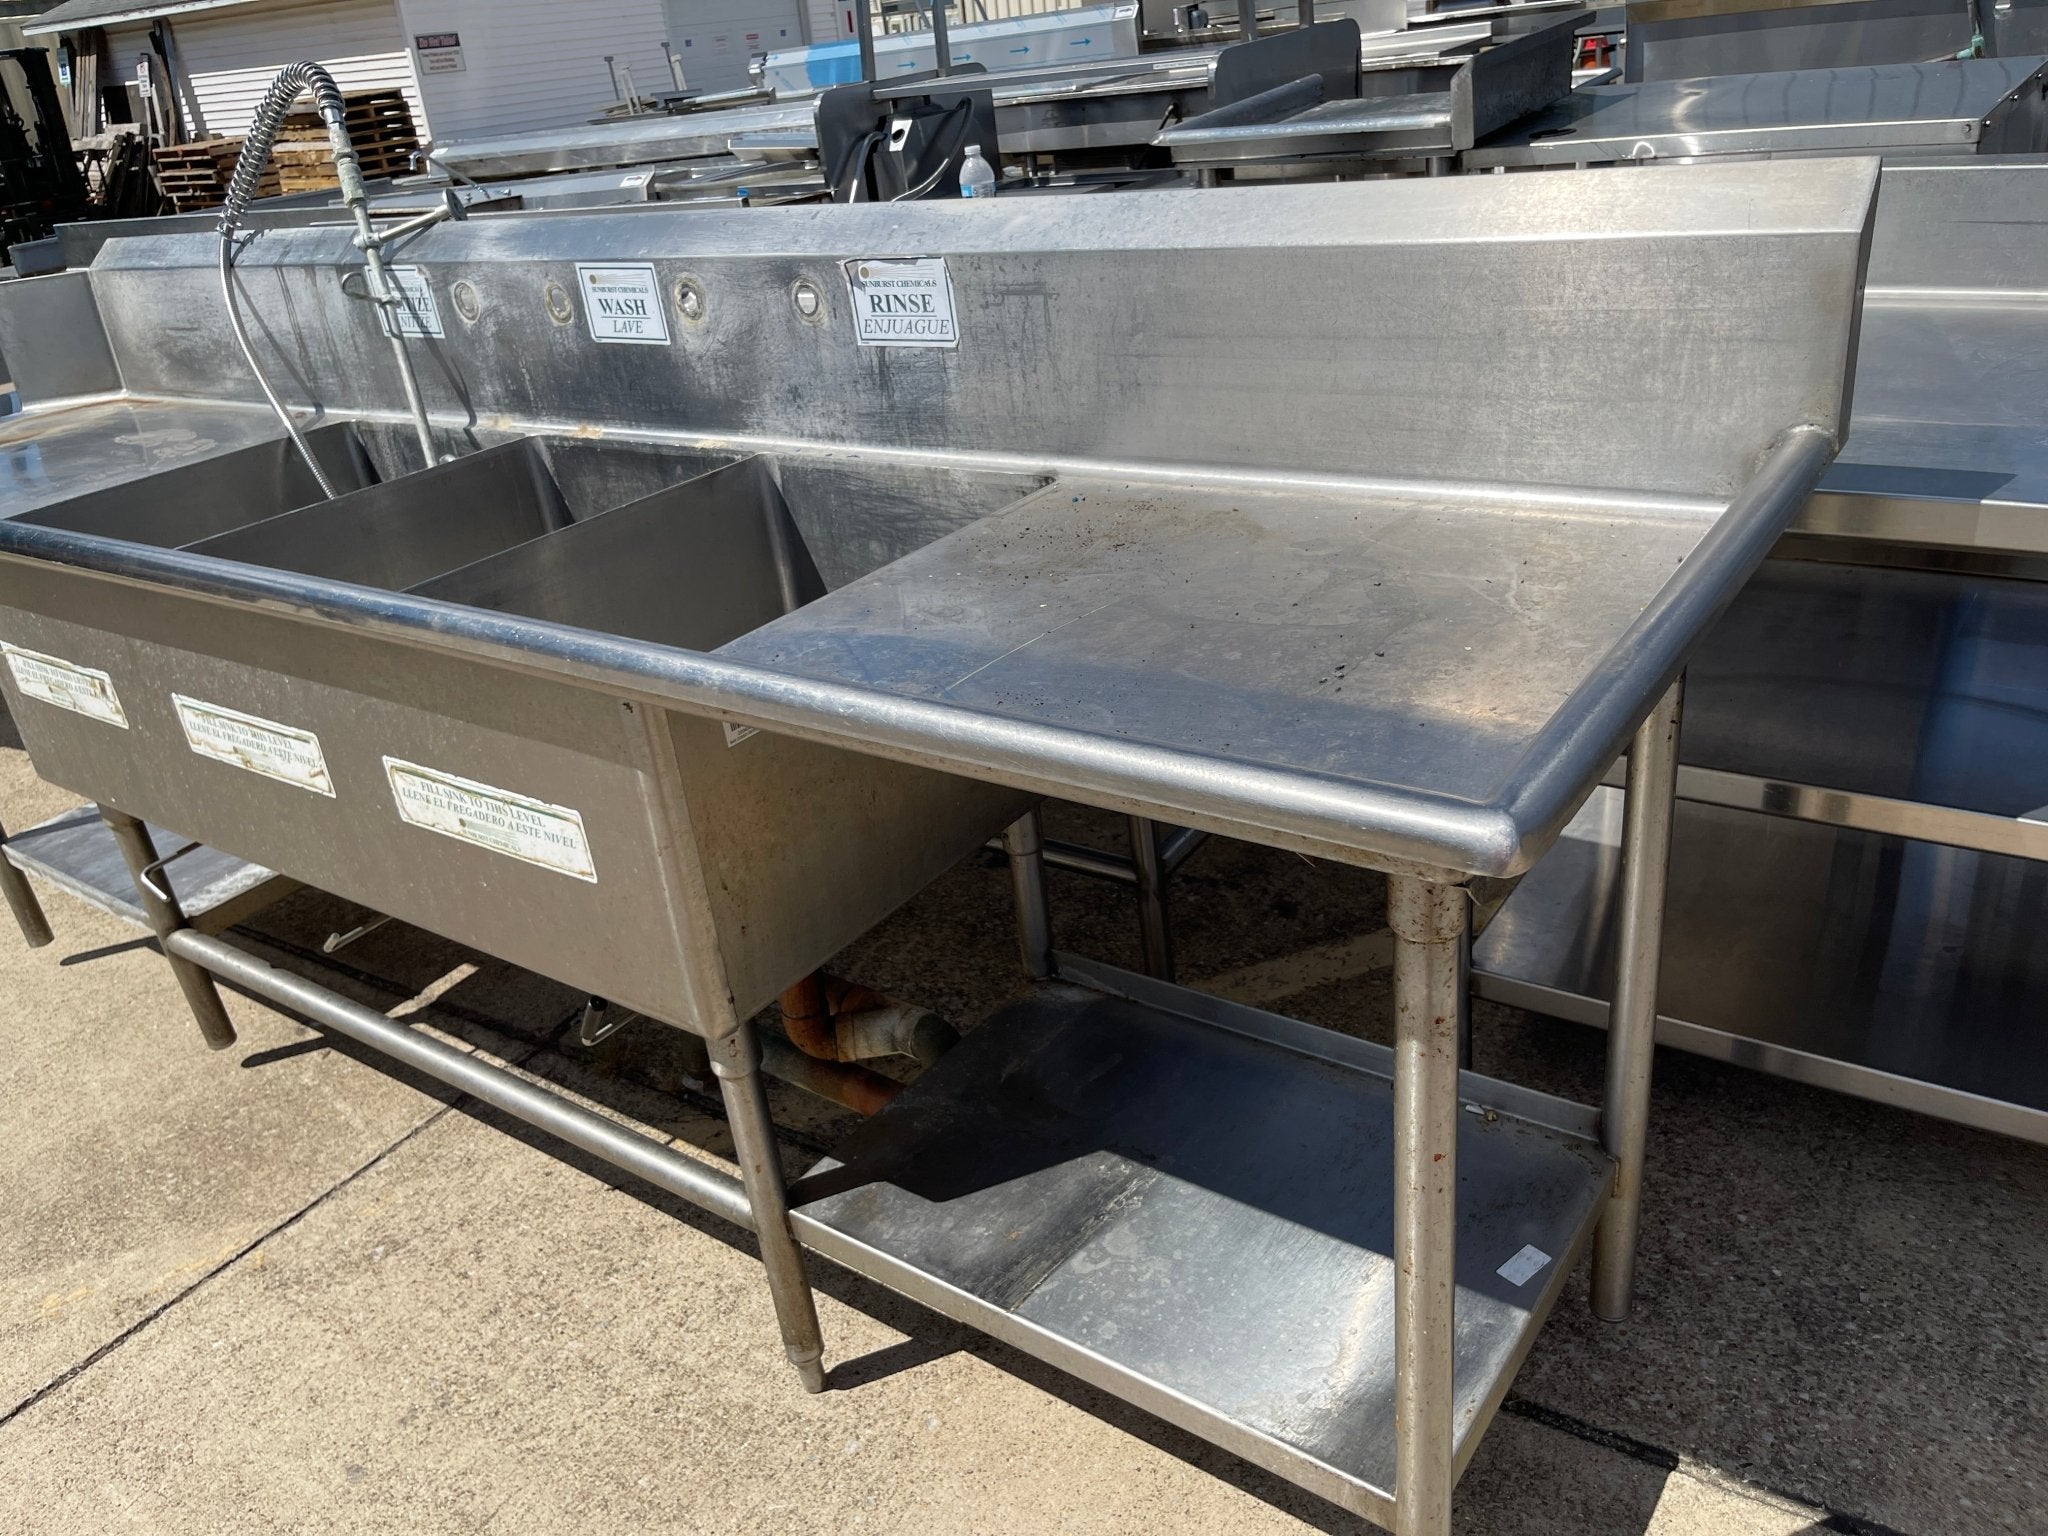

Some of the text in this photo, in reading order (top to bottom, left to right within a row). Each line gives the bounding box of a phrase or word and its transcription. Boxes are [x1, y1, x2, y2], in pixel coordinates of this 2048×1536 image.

[896, 280, 937, 288] CHEMICALS
[597, 298, 648, 316] WASH
[868, 293, 935, 313] RINSE
[614, 319, 644, 334] LAVE
[864, 318, 950, 335] ENJUAGUE
[421, 782, 546, 827] FILL SINK TO THIS LEVEL
[402, 788, 576, 849] LLENE EL FREGADERO A ESTE NIVEL
